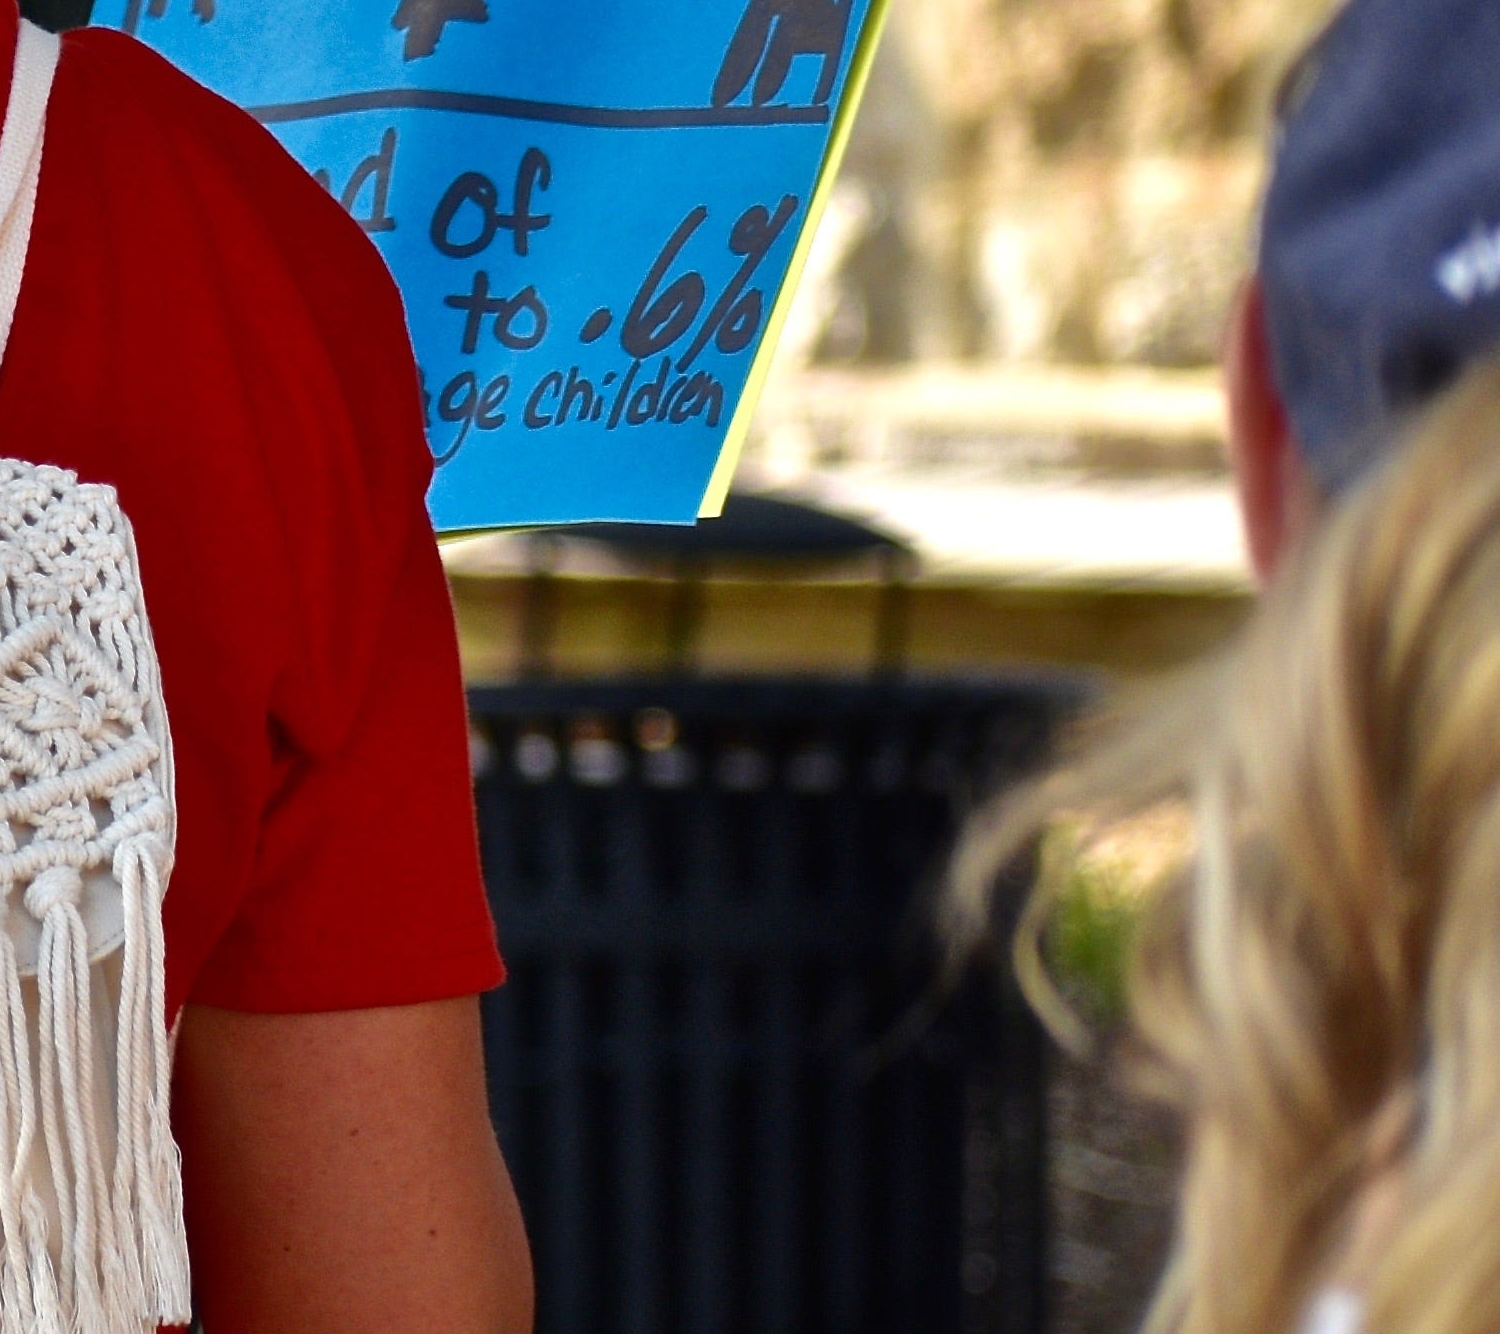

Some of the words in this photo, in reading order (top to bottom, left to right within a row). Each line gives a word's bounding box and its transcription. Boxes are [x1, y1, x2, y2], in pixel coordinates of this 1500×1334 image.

[429, 145, 553, 260] of
[443, 268, 550, 356] to
[578, 192, 800, 374] .6%
[522, 353, 727, 433] children
